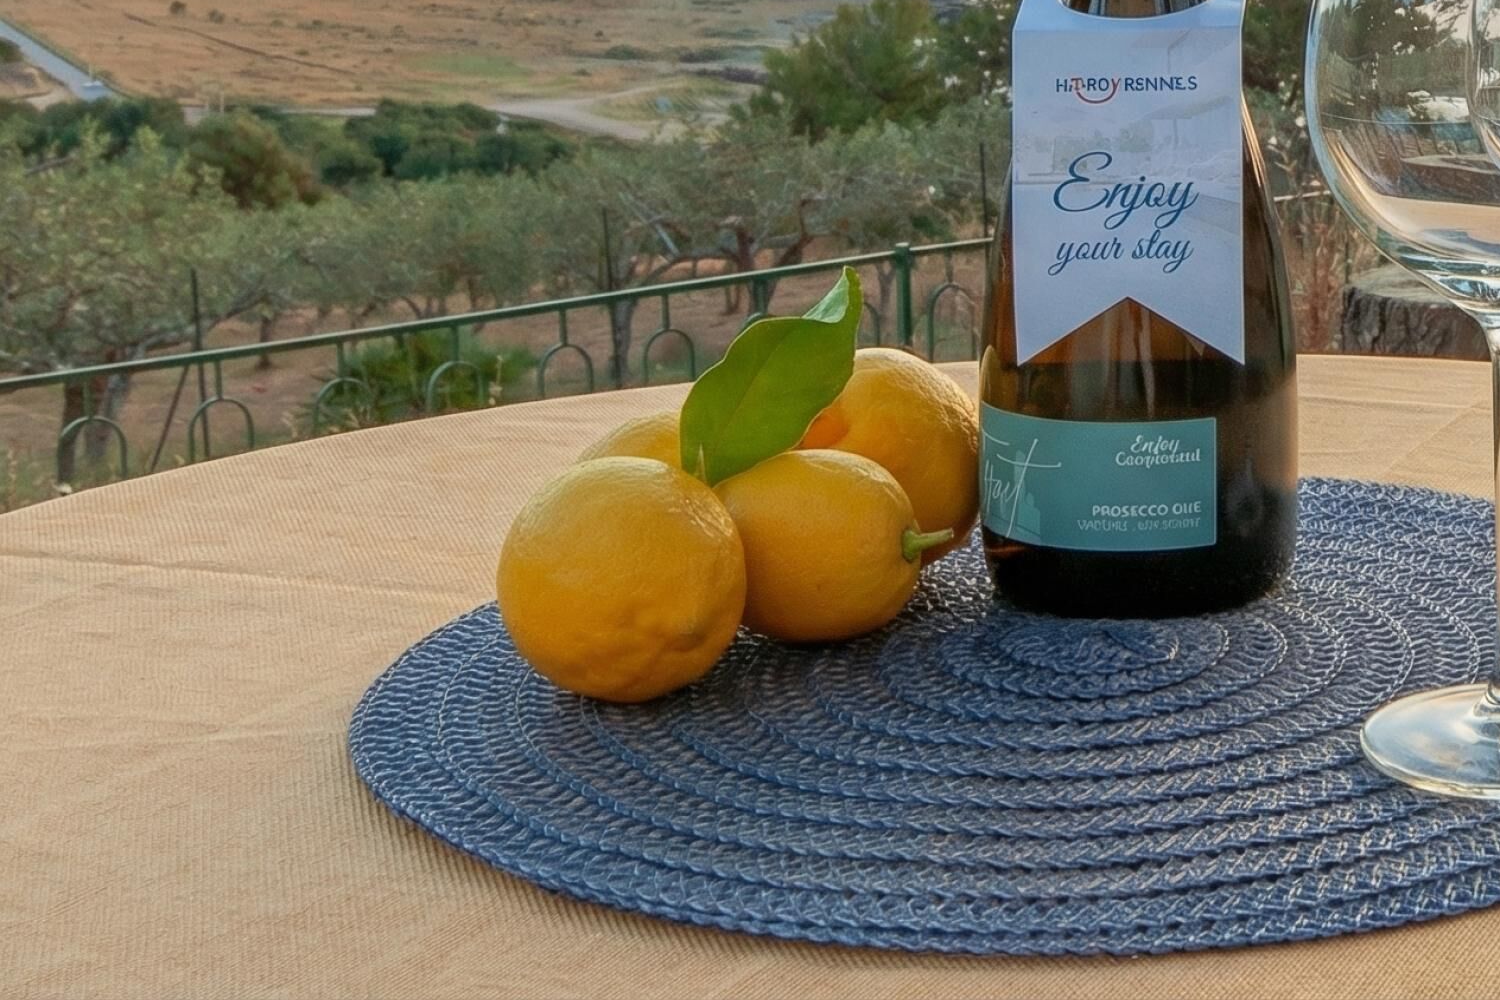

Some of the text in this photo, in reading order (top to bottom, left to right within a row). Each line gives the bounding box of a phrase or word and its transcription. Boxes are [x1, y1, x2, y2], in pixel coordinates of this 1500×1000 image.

[1053, 151, 1199, 230] Enjoy
[1047, 229, 1195, 276] your stay
[1130, 434, 1180, 454] Enjoy
[1092, 503, 1169, 518] PROSECCO
